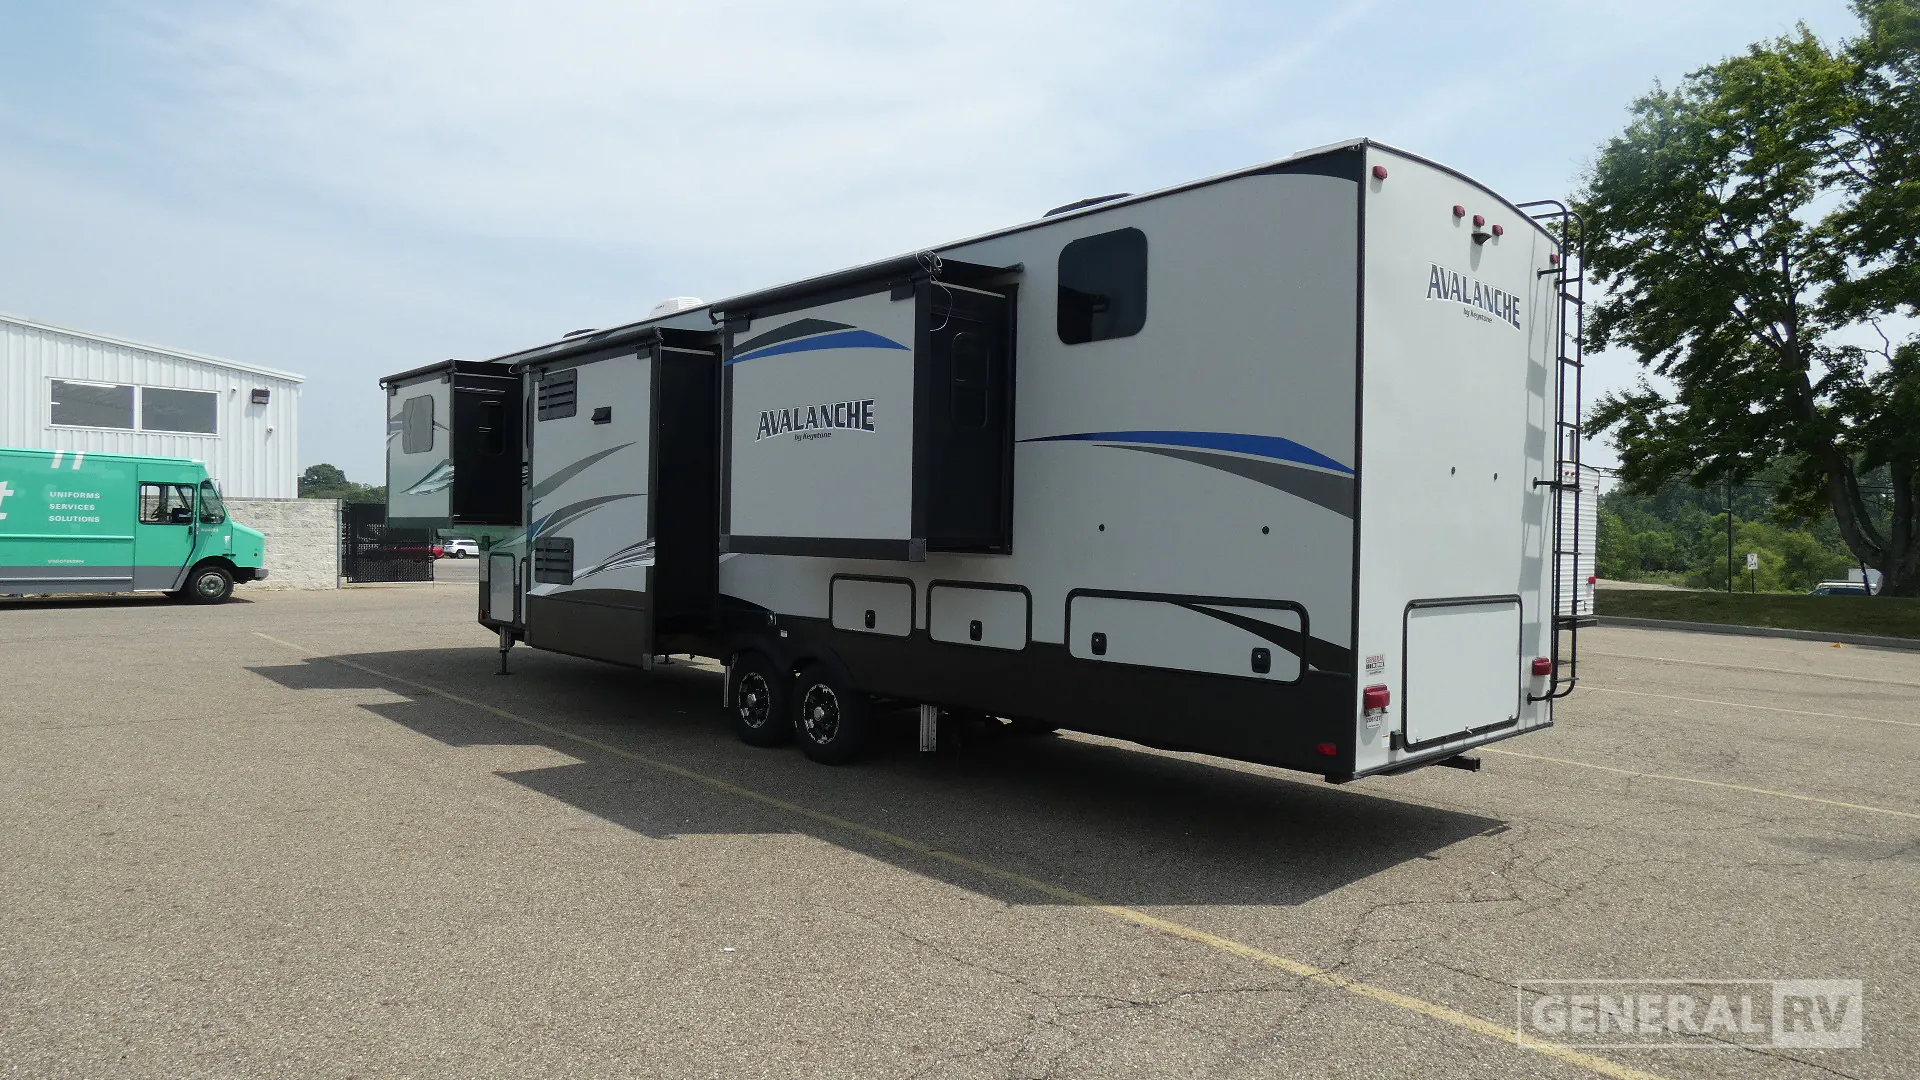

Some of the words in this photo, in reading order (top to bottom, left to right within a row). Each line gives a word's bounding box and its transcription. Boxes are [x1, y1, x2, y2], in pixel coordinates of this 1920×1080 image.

[1426, 261, 1520, 332] AVALANCHE
[755, 399, 875, 442] AVALANCHE
[49, 491, 100, 499] UNIFORMS
[49, 503, 95, 511] SERVICES
[49, 515, 100, 523] SOLUTIONS
